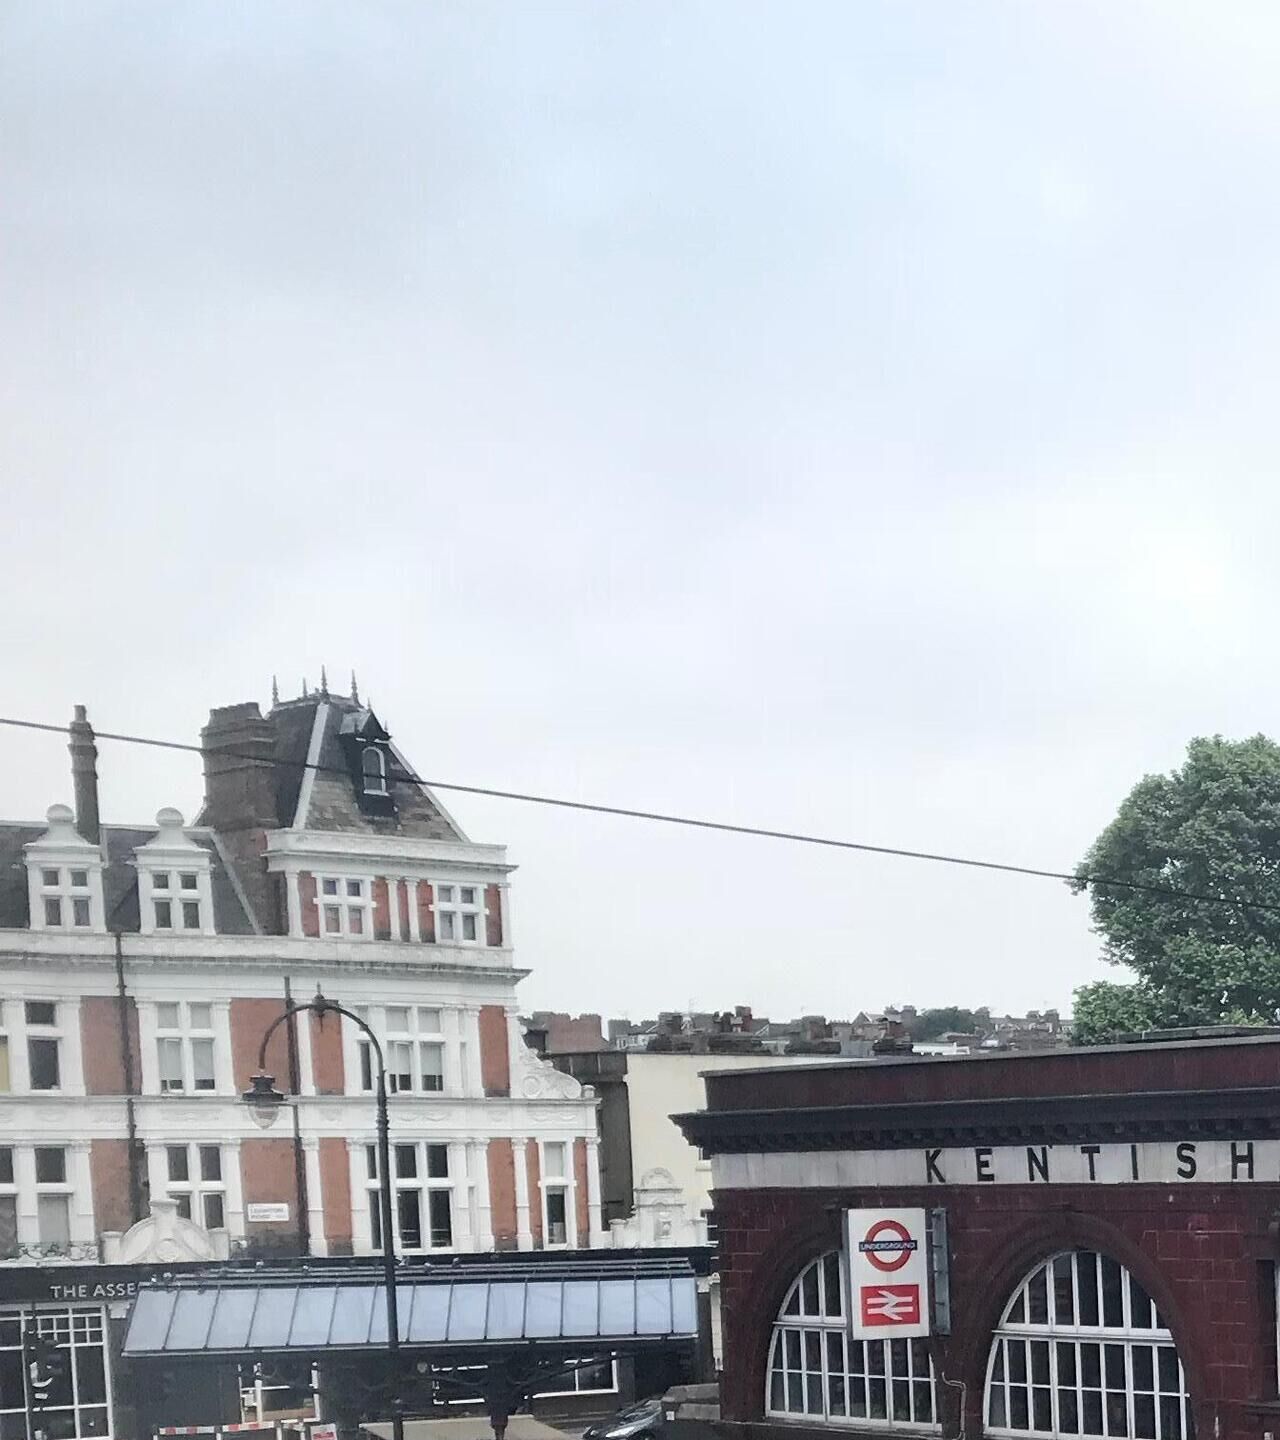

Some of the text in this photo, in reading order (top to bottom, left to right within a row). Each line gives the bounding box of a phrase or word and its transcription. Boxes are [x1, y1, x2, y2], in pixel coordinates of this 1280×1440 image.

[925, 1141, 1254, 1184] KENTISH
[861, 1241, 916, 1251] UNDERGROUND
[50, 1284, 88, 1299] THE
